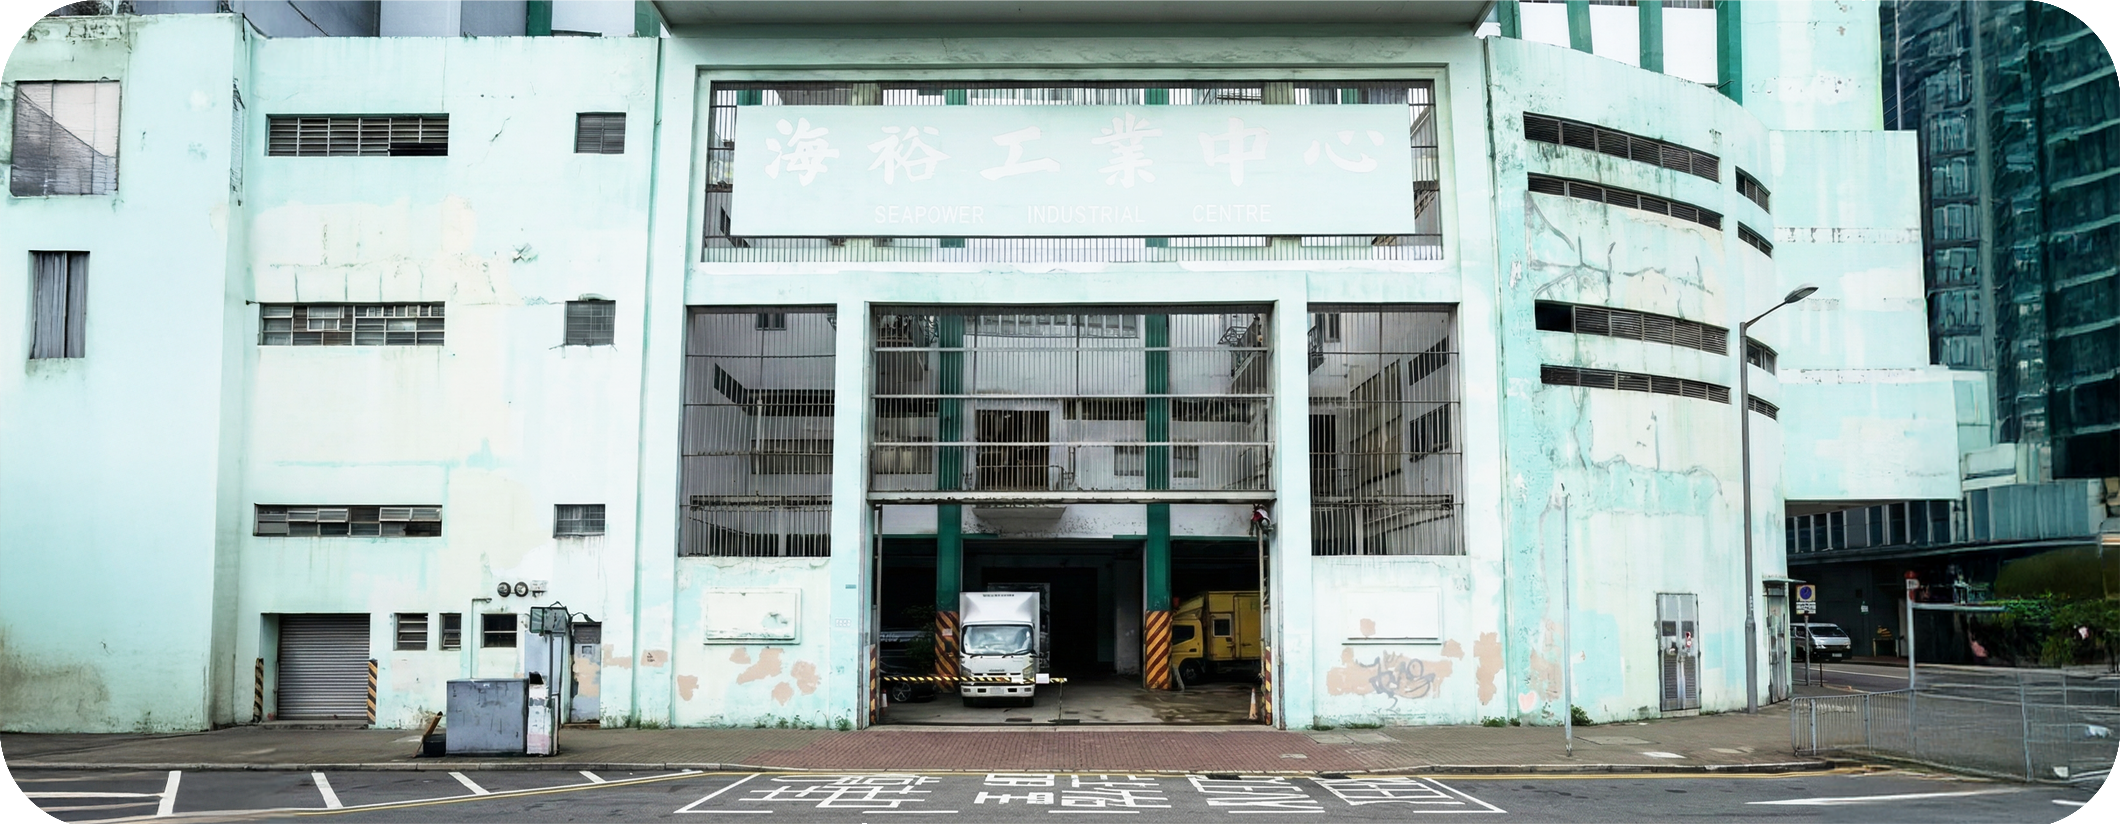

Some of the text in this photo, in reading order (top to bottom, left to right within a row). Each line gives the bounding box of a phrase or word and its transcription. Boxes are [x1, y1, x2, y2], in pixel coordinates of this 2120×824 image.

[764, 112, 1385, 188] 海裕工業中心
[874, 203, 1272, 224] SEAPOWER INDUSTRIAL CENTRE
